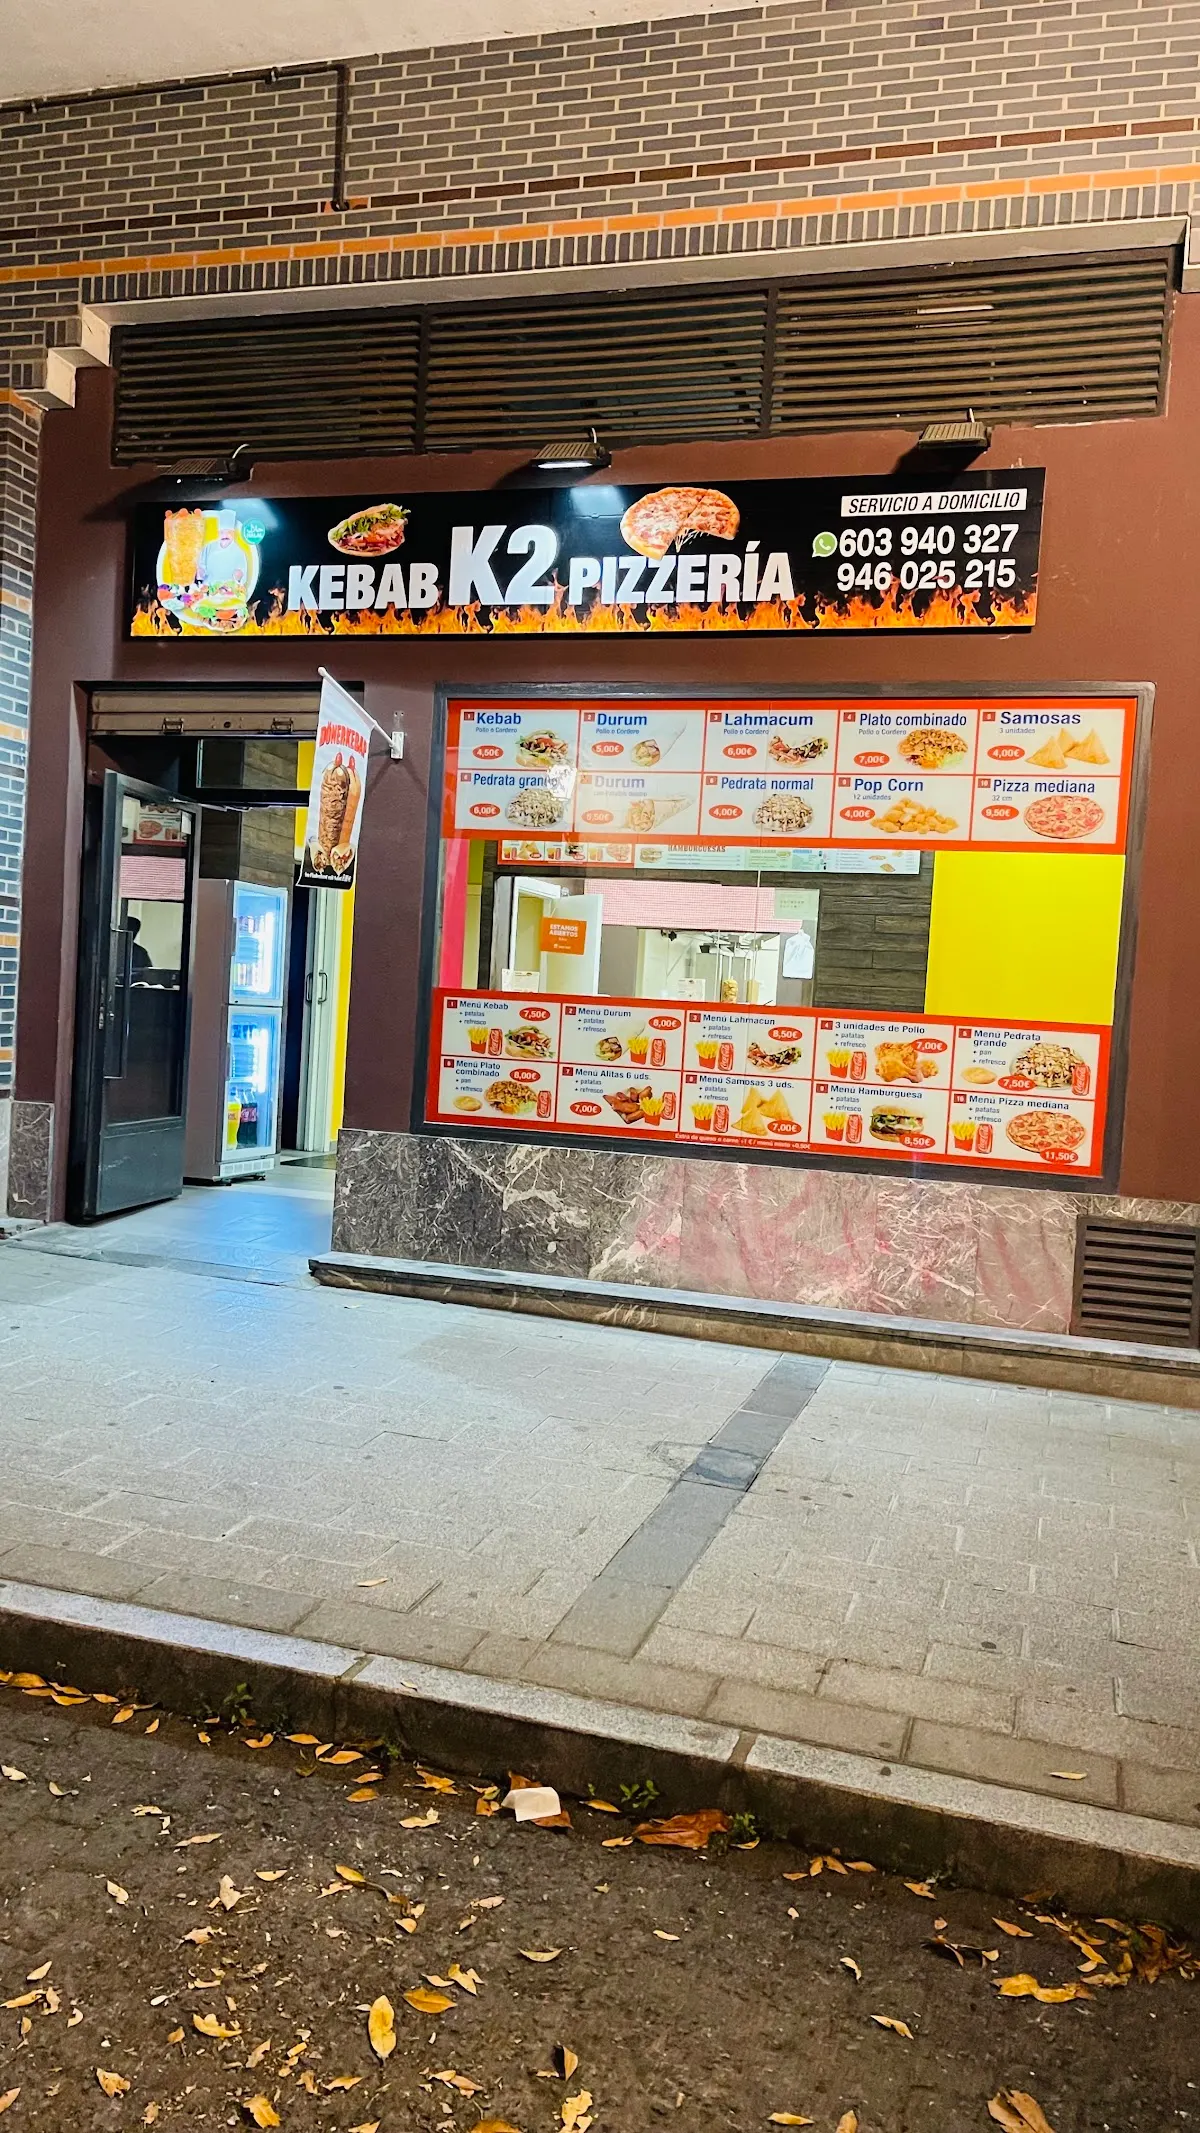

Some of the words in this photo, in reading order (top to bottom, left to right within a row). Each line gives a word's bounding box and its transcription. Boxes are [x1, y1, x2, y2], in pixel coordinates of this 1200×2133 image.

[849, 496, 918, 513] SERVICIO
[922, 496, 933, 511] A
[938, 492, 1021, 510] DOMICILIO
[839, 527, 893, 558] 603
[900, 525, 956, 556] 940
[962, 523, 1019, 554] 327
[288, 563, 439, 610] KEBAB
[449, 525, 559, 606] K2
[568, 541, 795, 606] PIZZERÍA
[837, 561, 892, 592] 946
[900, 560, 956, 590] 025
[964, 558, 1016, 588] 215
[477, 712, 521, 725] Kebab
[597, 713, 647, 726] Durum
[725, 713, 813, 726] Lahmacum
[860, 713, 892, 726] Plato
[896, 713, 967, 726] combinado
[1000, 711, 1081, 725] Samosas
[477, 749, 500, 757] 4,50€
[596, 745, 620, 754] 5,00€
[728, 748, 753, 756] 6,00€
[992, 749, 1020, 758] 4,00€
[859, 756, 885, 764] 7,00€
[473, 773, 515, 786] Pedrata
[594, 775, 645, 788] Durum
[721, 776, 767, 790] Pedrata
[771, 777, 814, 791] normal
[854, 778, 876, 793] Pop
[888, 778, 924, 791] Corn
[993, 779, 1030, 792] Pizza
[1034, 780, 1095, 793] mediana
[473, 806, 497, 815] 6,00€
[712, 807, 738, 817] 4,00€
[844, 809, 873, 818] 4,00€
[985, 808, 1011, 818] 9,50€
[483, 1002, 509, 1010] Kebab
[523, 1010, 547, 1019] 7,50€
[603, 1009, 631, 1017] Durum
[652, 1019, 677, 1028] 8,00€
[703, 1014, 727, 1022] Menú
[729, 1016, 776, 1025] Lahmacun
[843, 1023, 885, 1032] unidades
[888, 1024, 900, 1033] de
[902, 1025, 925, 1034] Pollo
[772, 1030, 798, 1039] 8,50€
[1003, 1031, 1041, 1041] Pedrata
[917, 1041, 943, 1051] 7,00€
[973, 1039, 1007, 1048] grande
[480, 1061, 501, 1070] Plato
[455, 1068, 500, 1077] combinado
[513, 1071, 537, 1080] 8,00€
[600, 1069, 624, 1078] Alitas
[725, 1077, 765, 1087] Samosas
[776, 1081, 795, 1089] uds.
[1003, 1079, 1031, 1088] 7,50€
[858, 1087, 923, 1099] Hamburguesa
[999, 1097, 1024, 1107] Pizza
[1027, 1100, 1069, 1110] mediana
[574, 1105, 598, 1113] 7,00€
[772, 1123, 798, 1132] 7,00€
[904, 1137, 931, 1146] 8,50€
[1045, 1152, 1076, 1161] 11,50€
